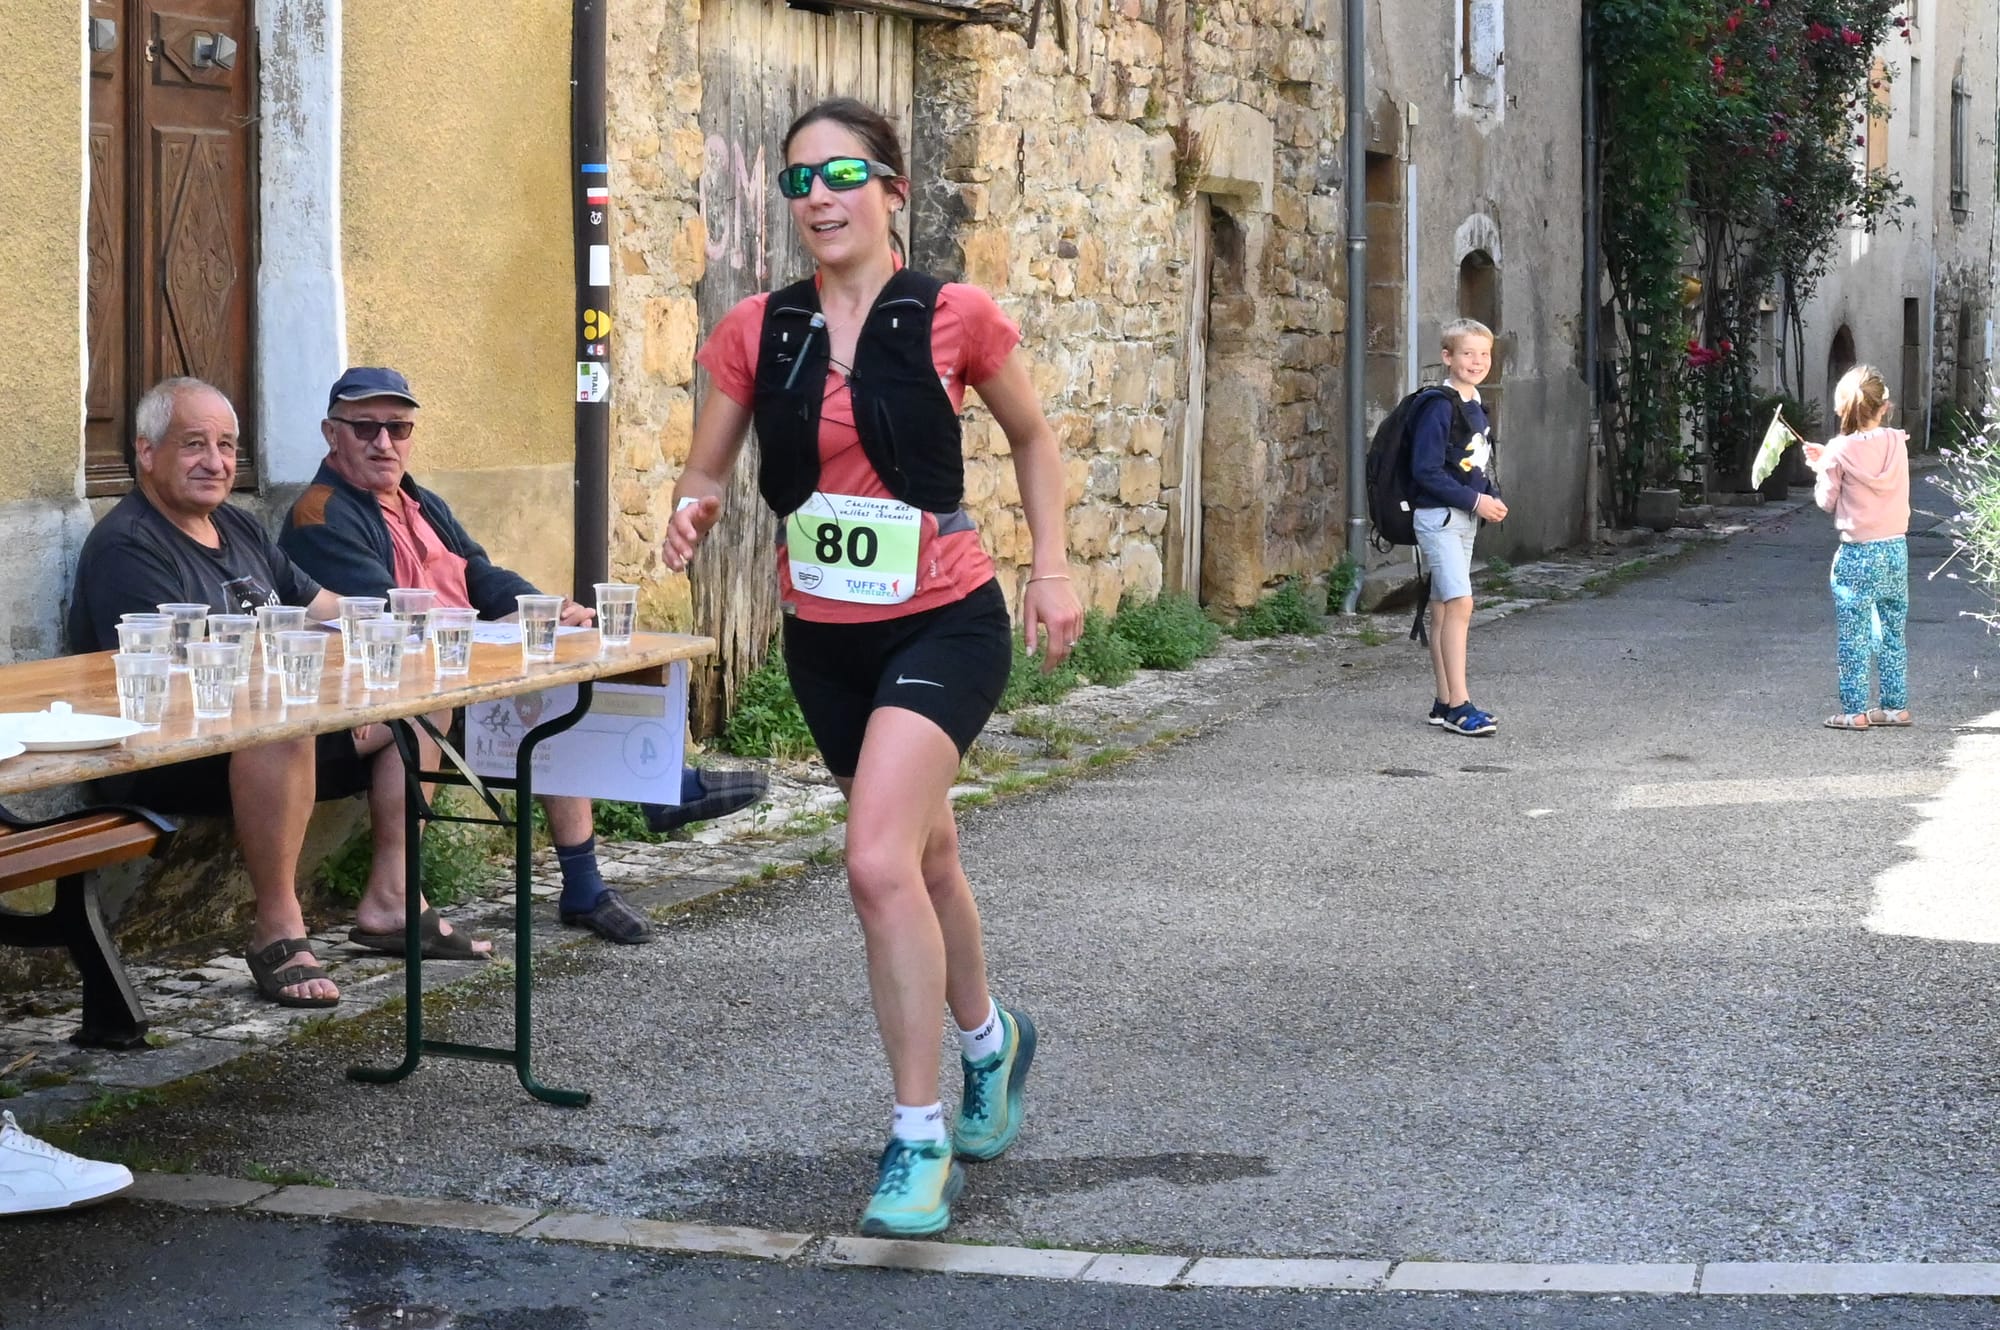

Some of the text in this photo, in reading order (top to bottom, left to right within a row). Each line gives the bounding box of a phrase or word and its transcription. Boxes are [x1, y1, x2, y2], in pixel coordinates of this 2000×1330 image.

[845, 500, 910, 512] Challenge des
[815, 522, 878, 567] 80
[846, 579, 887, 591] TUFF'S
